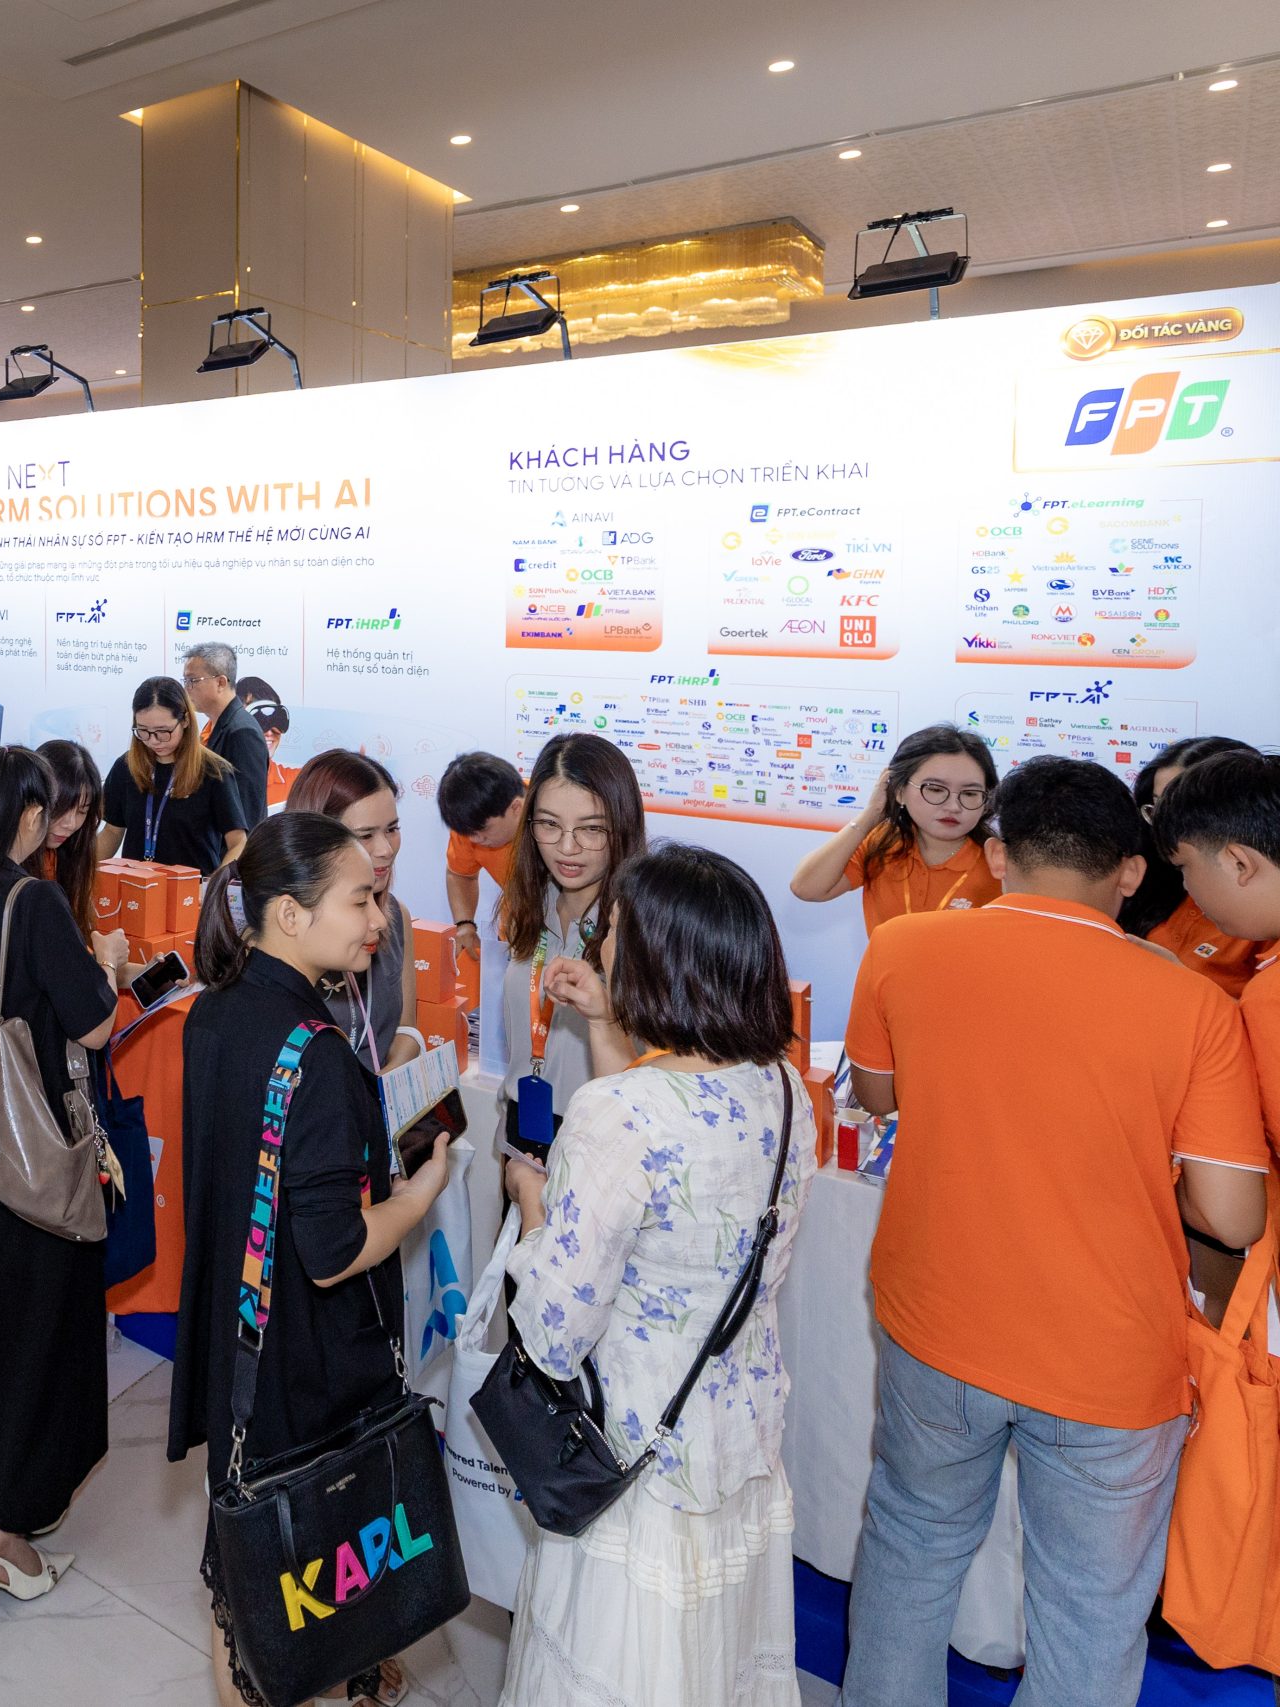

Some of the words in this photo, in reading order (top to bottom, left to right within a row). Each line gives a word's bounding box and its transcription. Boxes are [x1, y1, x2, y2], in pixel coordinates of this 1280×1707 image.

[1119, 323, 1149, 341] ĐỐI
[1154, 319, 1182, 339] TÁC
[1186, 316, 1232, 334] VÀNG
[1068, 382, 1226, 447] FPT
[509, 444, 598, 470] KHÁCH
[608, 438, 691, 464] HÀNG
[8, 461, 70, 490] NEXT
[508, 477, 534, 494] TIN
[609, 471, 632, 489] VÀ
[639, 470, 677, 491] LỰA
[681, 466, 745, 488] CHỌN
[751, 460, 809, 482] TRIỂN
[817, 462, 870, 481] KHAI
[38, 487, 217, 521] SOLUTIONS
[226, 481, 320, 514] WITH
[335, 477, 370, 508] AI
[572, 512, 614, 522] AINAVI
[777, 507, 861, 517] FPT.eContract
[39, 532, 69, 547] NHÂN
[71, 534, 87, 550] SỰ
[88, 531, 104, 546] SỐ
[106, 533, 127, 546] FPT
[137, 529, 164, 545] KIẾN
[167, 532, 193, 547] TẠO
[196, 531, 224, 544] HRM
[227, 525, 253, 542] THẾ
[256, 526, 274, 545] HỆ
[277, 525, 306, 542] MỚI
[308, 524, 352, 541] CÙNG
[355, 526, 370, 540] AI
[991, 526, 1022, 536] OCB
[581, 569, 613, 581] OCB
[840, 594, 880, 607] KFC
[56, 612, 101, 623] FPT.AI
[196, 616, 261, 628] FPT.eContract
[326, 617, 391, 630] FPT.iHRP
[843, 619, 871, 630] UNI
[719, 627, 768, 639] Goertek
[843, 632, 872, 646] QLO
[256, 644, 277, 657] điện
[326, 647, 340, 659] Hệ
[342, 647, 371, 662] thống
[374, 648, 400, 663] quản
[326, 661, 350, 673] nhân
[352, 663, 365, 675] sự
[366, 660, 379, 674] số
[381, 663, 404, 675] toàn
[407, 664, 430, 678] diện
[650, 674, 710, 686] FPT.iHRP
[1030, 691, 1101, 704] FPT.AI
[725, 713, 746, 721] OCB
[477, 1459, 510, 1476] Talen
[452, 1467, 496, 1493] Powered
[498, 1484, 512, 1498] by
[279, 1503, 434, 1632] KARL
